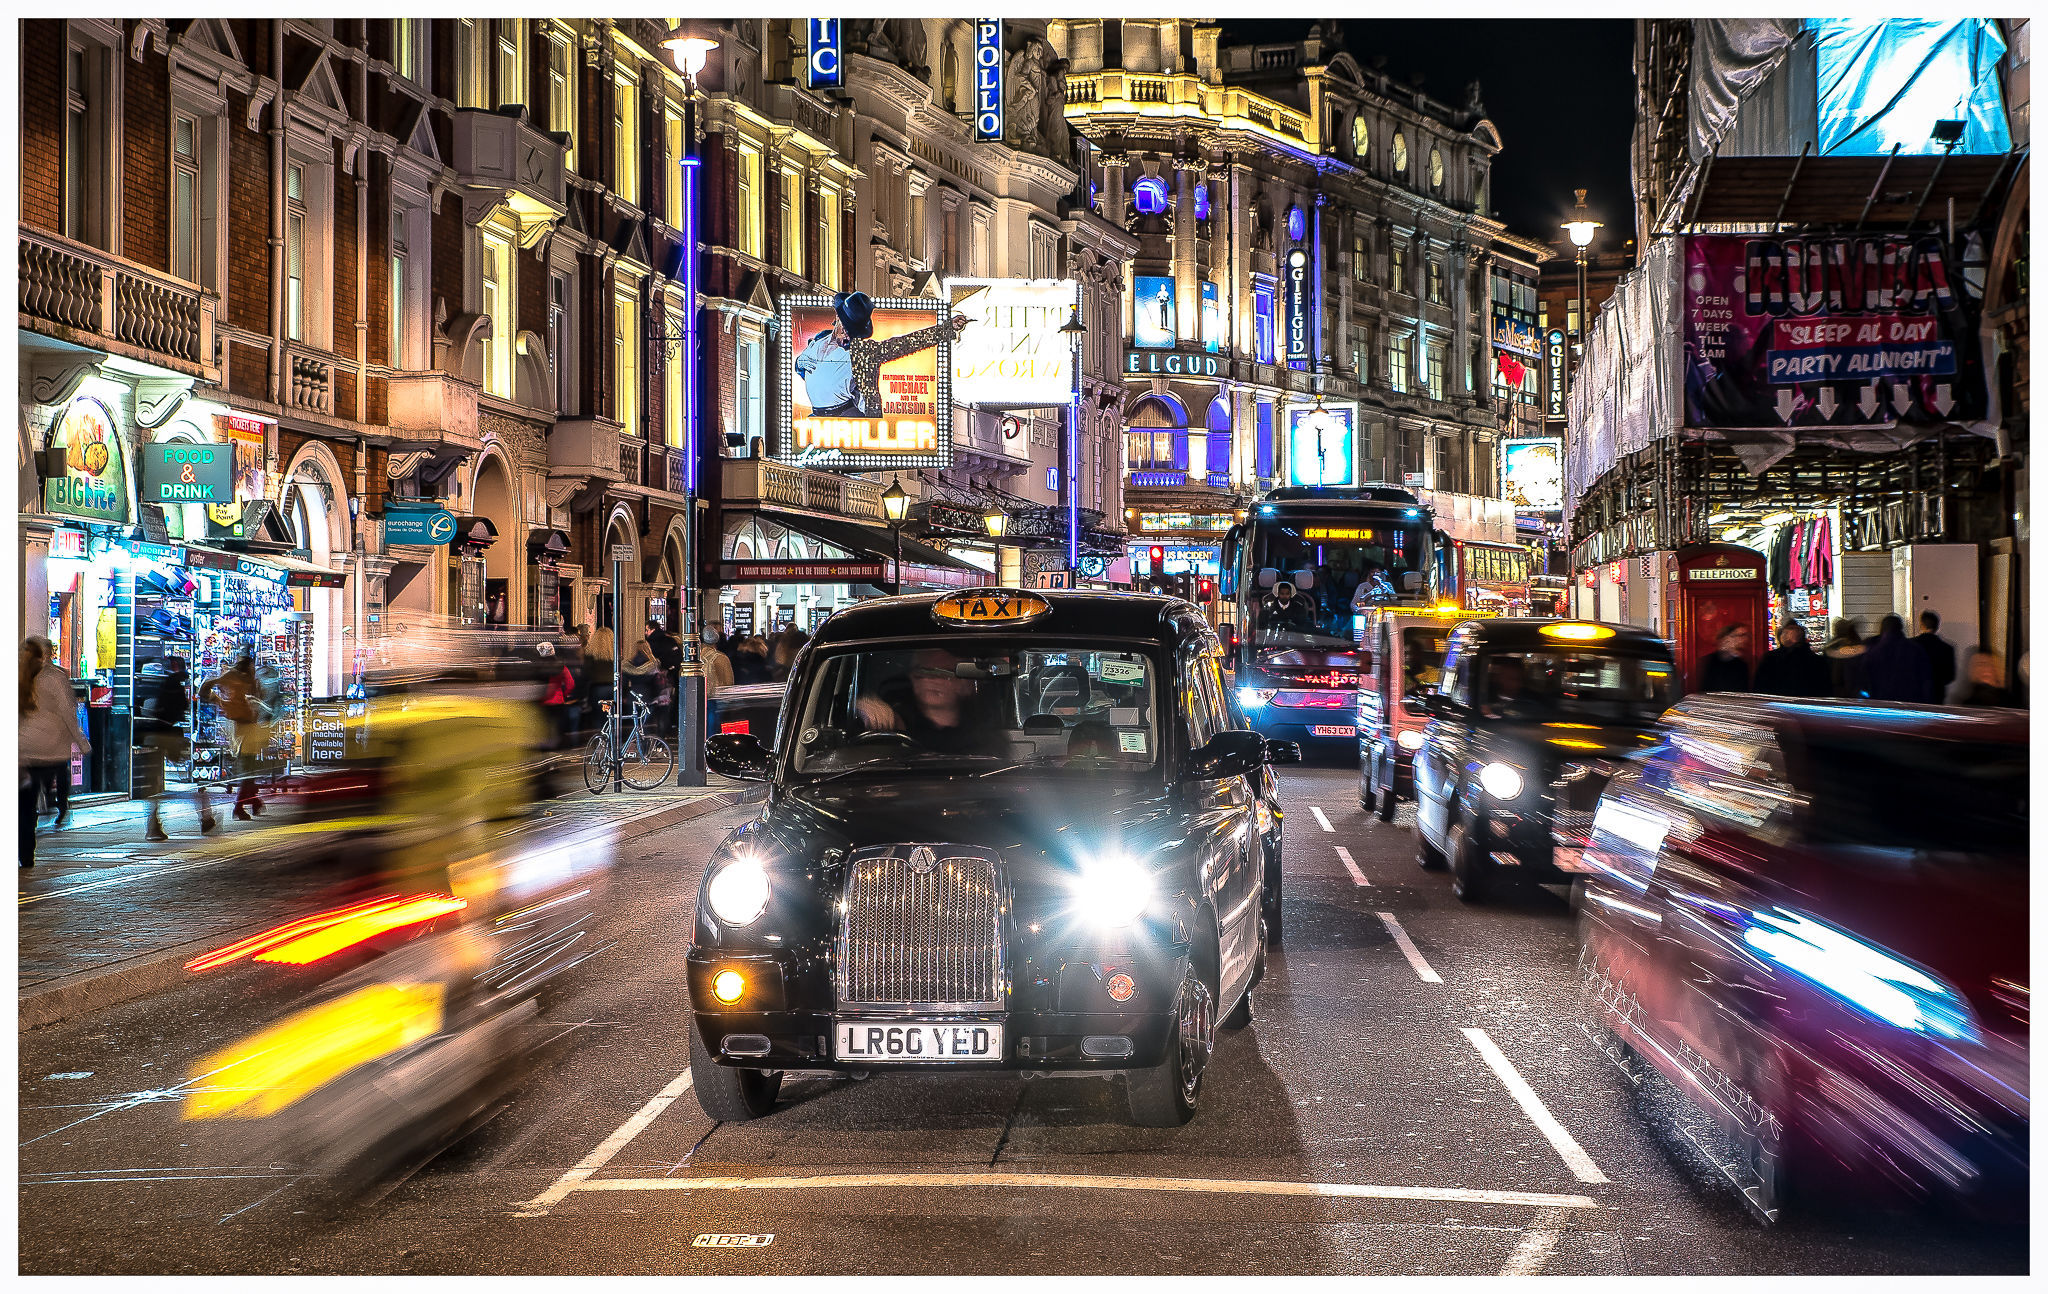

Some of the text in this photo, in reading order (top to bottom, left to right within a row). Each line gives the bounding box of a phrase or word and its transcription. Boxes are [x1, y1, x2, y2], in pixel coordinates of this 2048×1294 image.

[977, 18, 999, 133] POLLO
[1696, 296, 1729, 305] OPEN
[1291, 268, 1305, 353] GIELGUD
[1691, 309, 1733, 319] 7 DAYS
[1493, 317, 1505, 343] Les
[1694, 322, 1730, 332] WEEK
[1890, 321, 1932, 341] DAY
[1698, 335, 1726, 345] TILL
[1699, 349, 1725, 358] 3AM
[1771, 354, 1842, 376] PARTY
[1551, 345, 1563, 414] QUEENS
[890, 382, 928, 394] MICHAEL
[883, 402, 935, 414] JACKSON 5
[232, 417, 250, 431] TICKETS
[794, 419, 936, 448] THRILLER
[163, 449, 214, 464] FOOD
[180, 464, 196, 483] &
[160, 484, 215, 498] DRINK
[1177, 551, 1213, 561] INCIDENT
[743, 567, 759, 575] WANT
[760, 567, 771, 575] YOU
[772, 567, 787, 575] BACK
[805, 567, 813, 575] BE
[813, 567, 830, 575] THERE
[837, 567, 849, 575] CAN
[850, 567, 861, 575] YOU
[861, 567, 873, 575] FEEL
[1692, 570, 1753, 578] TELEPHONE
[956, 599, 1022, 617] TAXI
[1104, 666, 1130, 675] 73326
[312, 719, 344, 731] Cash
[1316, 726, 1354, 735] YH63 CXY
[312, 747, 343, 760] here
[848, 1027, 990, 1055] LR60 YED
